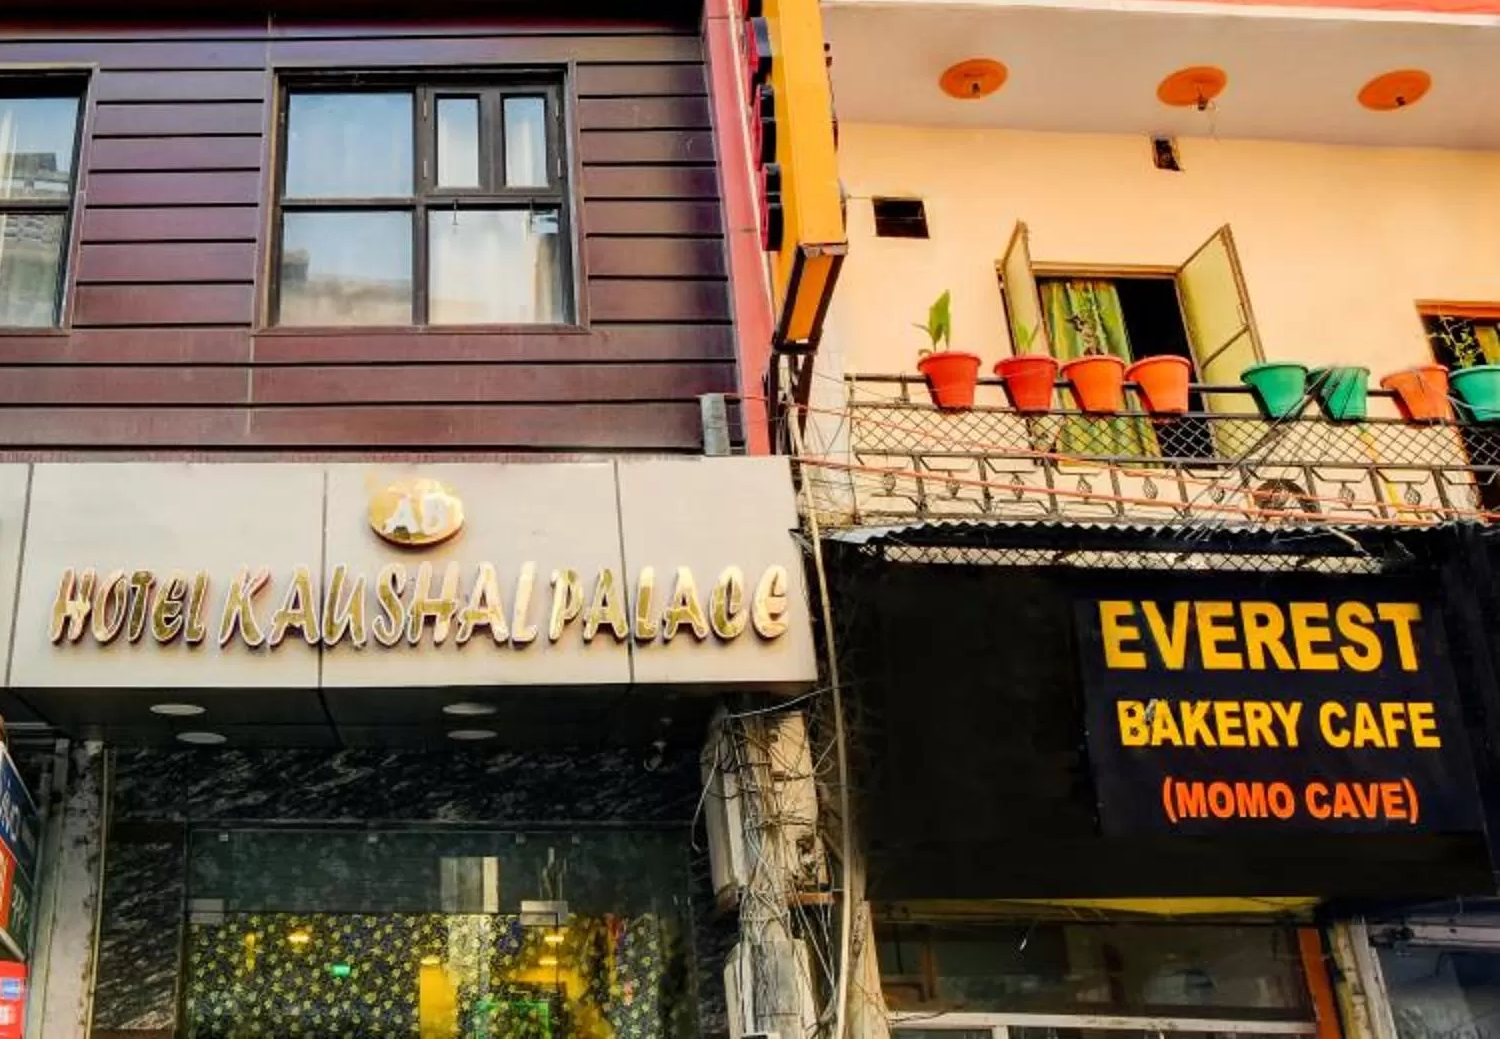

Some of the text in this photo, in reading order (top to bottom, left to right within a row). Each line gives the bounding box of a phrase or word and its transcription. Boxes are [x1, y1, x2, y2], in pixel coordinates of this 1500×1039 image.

[50, 560, 790, 649] HOTEL KAUSHAL PALACE
[1099, 599, 1422, 672] EVEREST
[1116, 699, 1442, 749] BAKERY CAFE
[1162, 776, 1420, 825] (MOMO CAVE)
